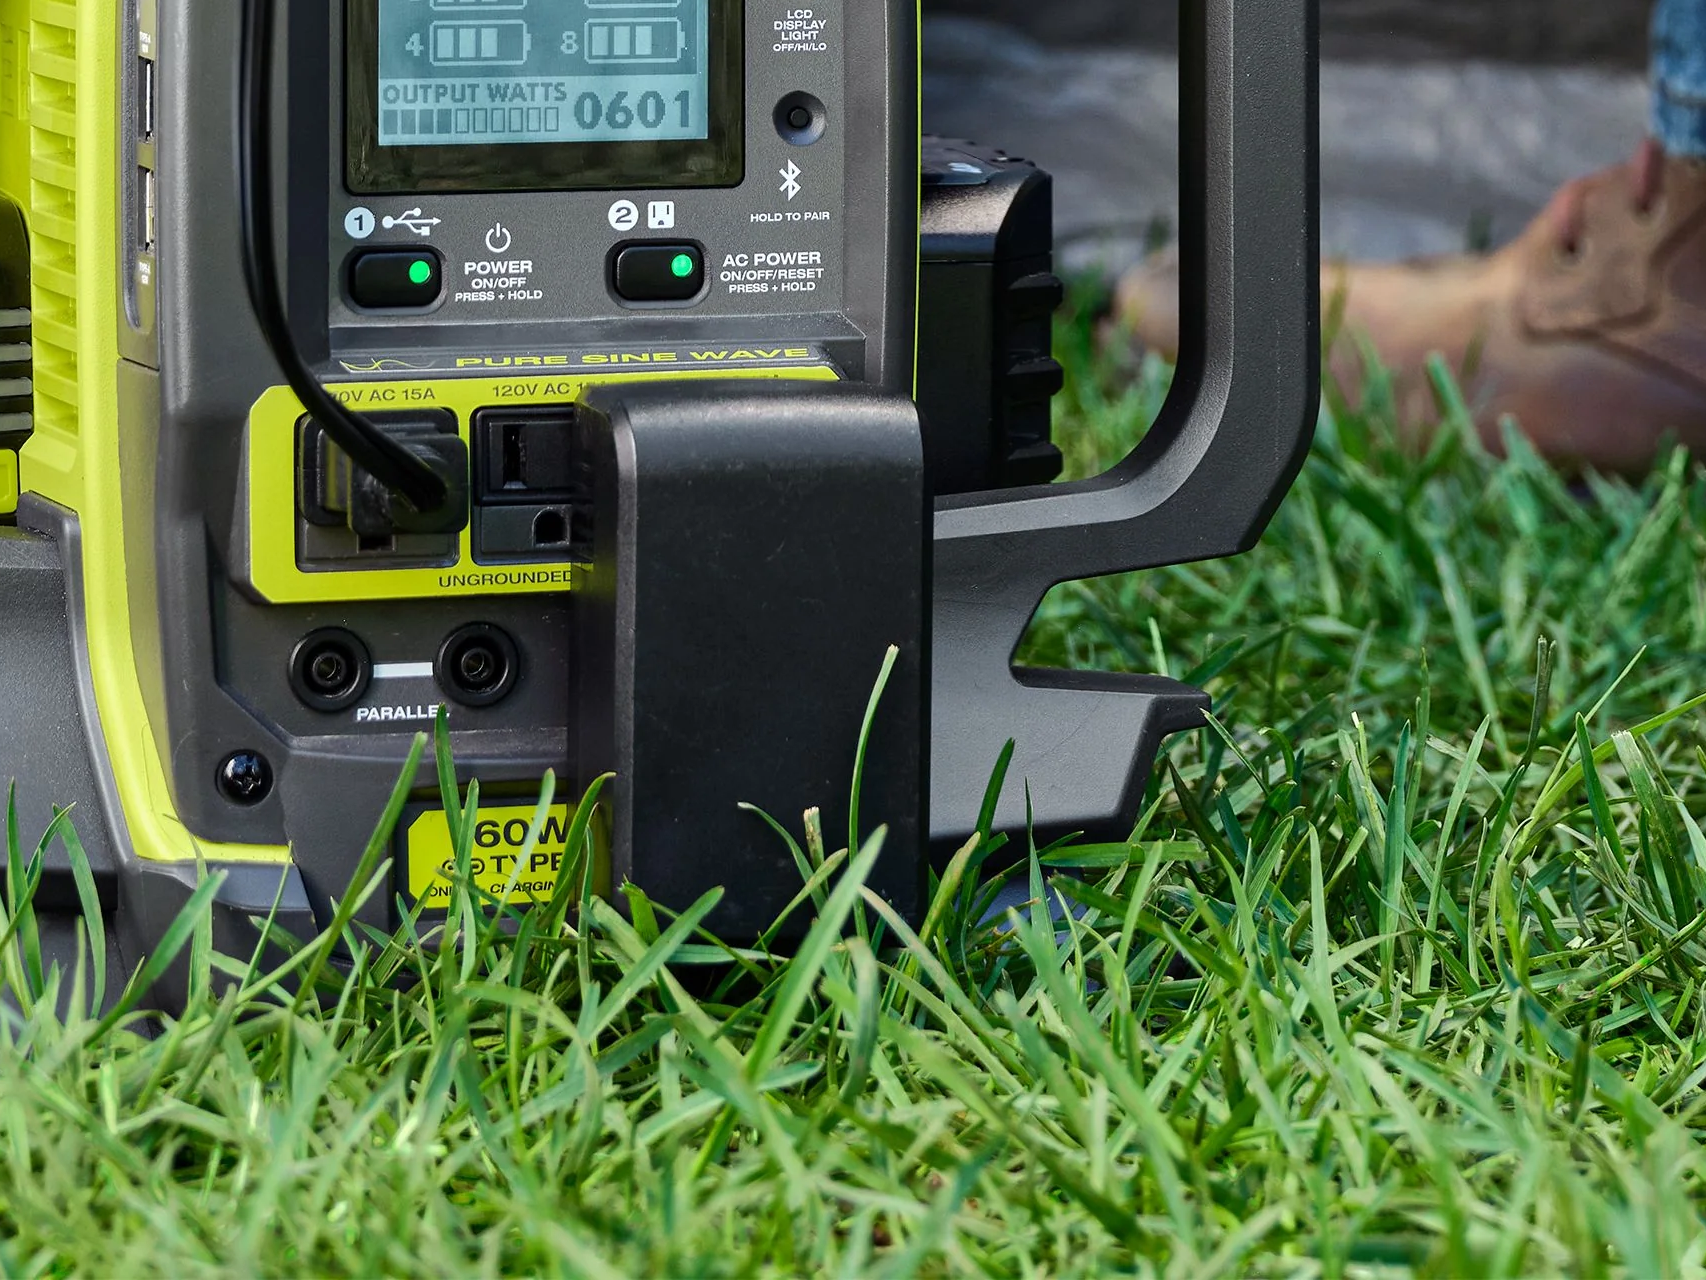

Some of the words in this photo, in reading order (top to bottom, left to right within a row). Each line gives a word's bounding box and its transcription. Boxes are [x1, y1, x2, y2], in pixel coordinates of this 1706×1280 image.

[787, 9, 813, 19] LCD
[773, 20, 827, 30] DISPLAY
[560, 31, 579, 55] 8
[781, 31, 819, 41] LIGHT
[405, 32, 425, 58] 4
[773, 42, 827, 52] OFF/HI/LO
[383, 83, 480, 104] OUTPUT
[487, 82, 567, 102] WATTS
[573, 89, 690, 130] 0601
[354, 214, 364, 231] 1
[614, 206, 633, 224] 2
[750, 213, 783, 222] HOLD
[785, 212, 801, 222] TO
[804, 211, 830, 221] PAIR
[722, 254, 749, 267] AC
[753, 252, 822, 266] POWER
[464, 260, 533, 275] POWER
[720, 268, 824, 282] ON/OFF/RESET
[471, 277, 527, 289] ON/OFF
[728, 283, 769, 294] PRESS
[781, 282, 816, 292] HOLD
[454, 291, 495, 302] PRESS
[508, 290, 543, 300] HOLD
[455, 354, 569, 368] PURE
[581, 351, 678, 365] SINE
[689, 348, 810, 361] WAVE
[369, 389, 396, 402] AC
[403, 388, 436, 401] 15A
[492, 383, 538, 397] 120V
[543, 382, 570, 395] AC
[439, 570, 572, 588] UNGROUNDED
[356, 704, 449, 721] PARALLE
[474, 816, 567, 848] 60W
